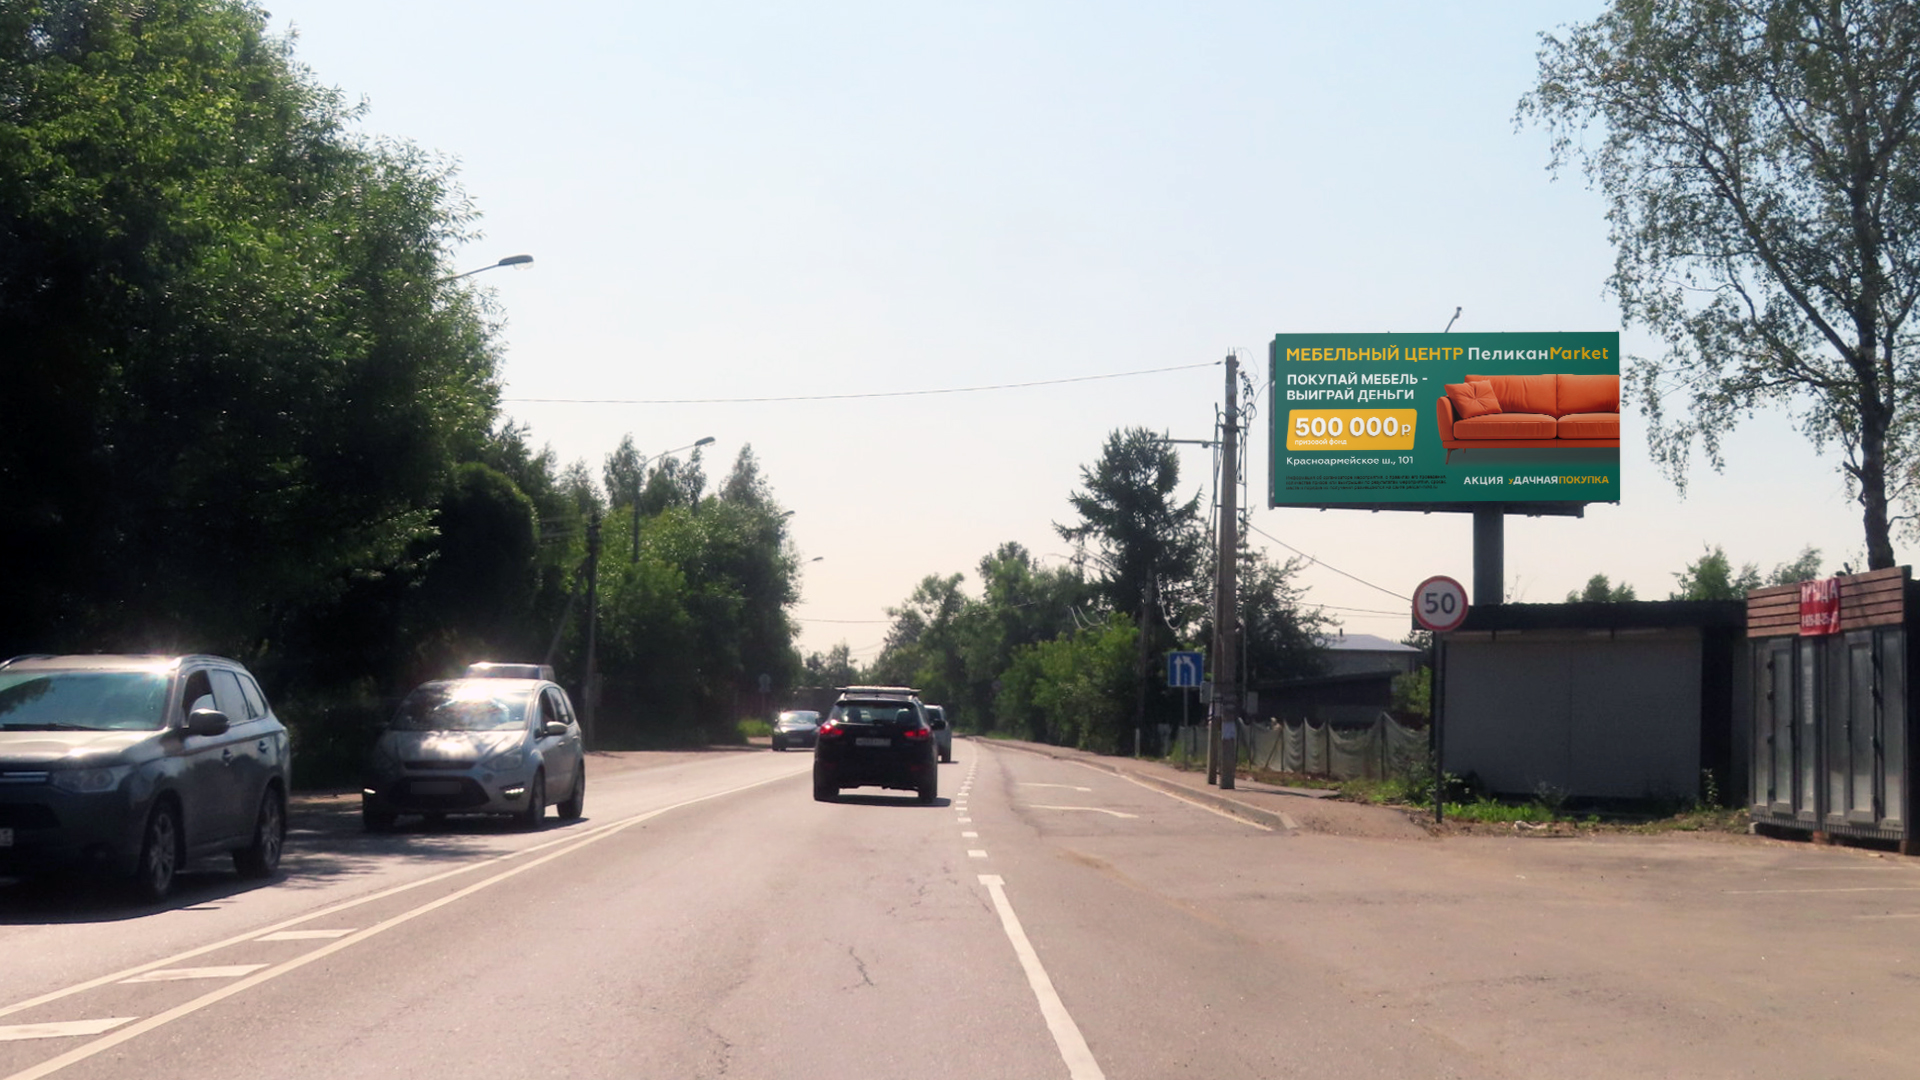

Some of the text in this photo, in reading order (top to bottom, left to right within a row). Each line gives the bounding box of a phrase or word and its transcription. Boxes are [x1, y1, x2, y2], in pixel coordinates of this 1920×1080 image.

[1286, 345, 1399, 361] МЕБЕЛЬНЫЙ
[1404, 347, 1464, 362] ЦЕНТР
[1287, 372, 1358, 385] ПОКУПАЙ
[1361, 374, 1418, 385] МЕБЕЛЬ
[1286, 387, 1414, 403] ВЫИГРАЙ ДЕНЬГИ
[1295, 417, 1343, 437] 500
[1294, 438, 1347, 446] призовой фонд
[1286, 457, 1380, 466] Красноармейское
[1398, 456, 1414, 464] 101
[1463, 476, 1504, 486] АКЦИЯ
[1425, 592, 1456, 615] 50
